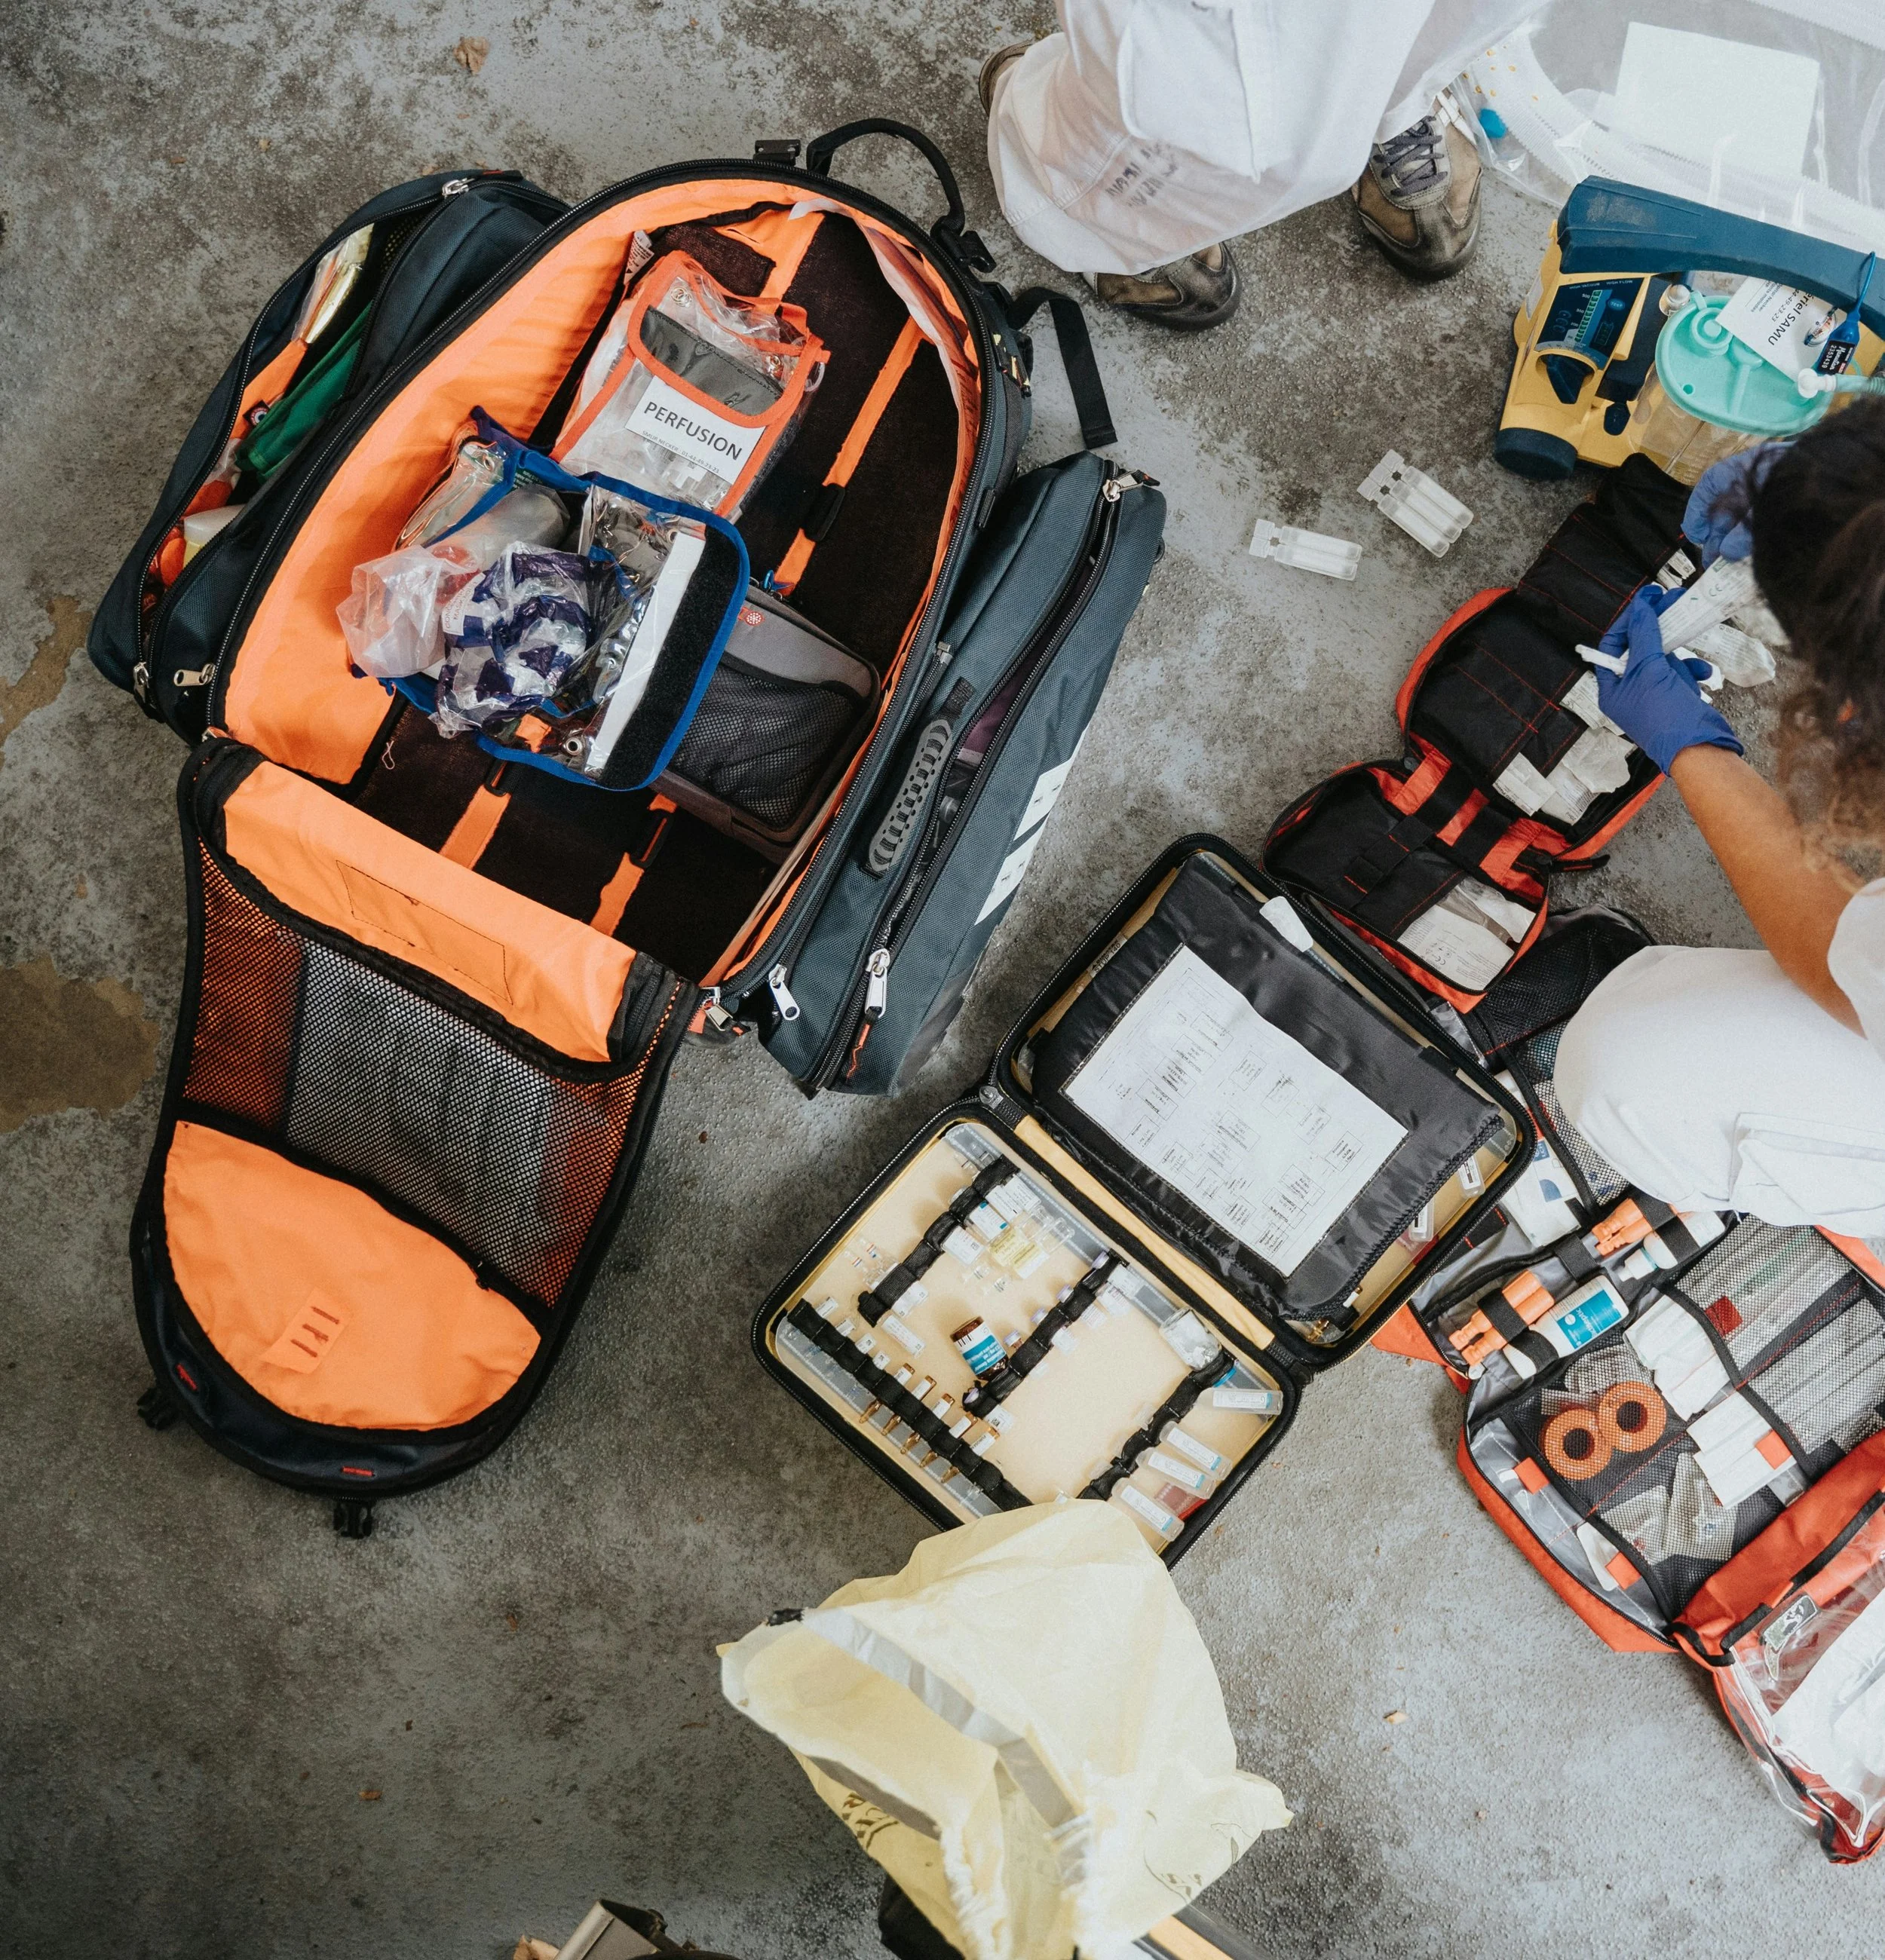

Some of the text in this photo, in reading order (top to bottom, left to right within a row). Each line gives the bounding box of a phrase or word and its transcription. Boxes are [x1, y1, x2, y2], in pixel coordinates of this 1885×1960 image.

[1766, 311, 1797, 347] SAMU
[643, 398, 743, 461] PERFUSION
[641, 430, 658, 442] SMUR
[657, 438, 679, 452] NECKER
[680, 450, 719, 473] 01-44-49-23-23
[1093, 942, 1121, 973] STUP 140
